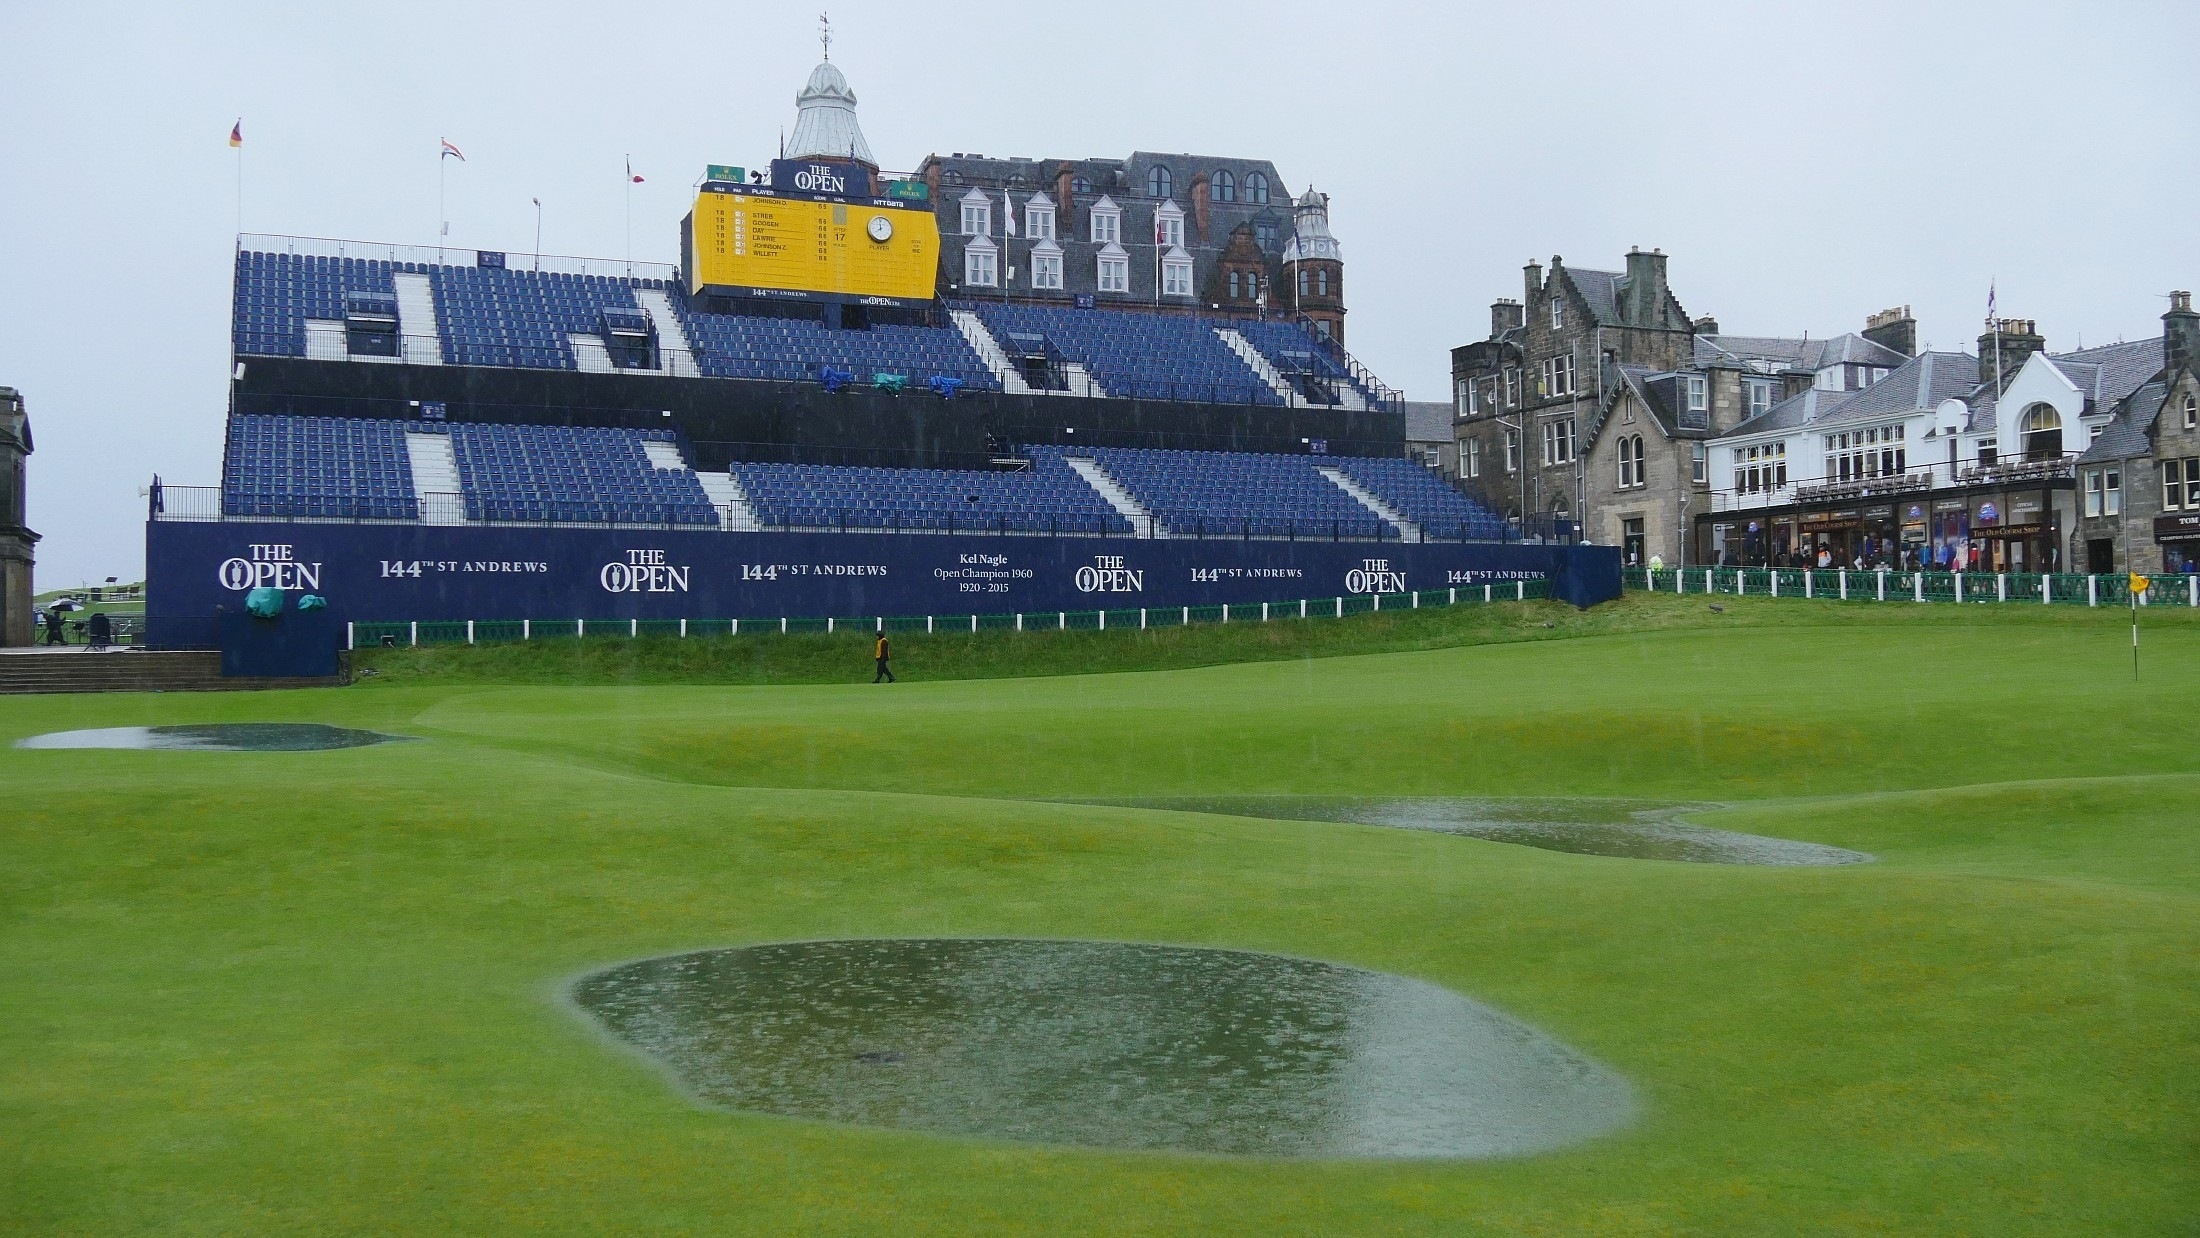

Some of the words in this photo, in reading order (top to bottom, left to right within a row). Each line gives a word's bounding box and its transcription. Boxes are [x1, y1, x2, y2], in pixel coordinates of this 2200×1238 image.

[809, 165, 831, 176] THE
[715, 173, 737, 181] ROLEX
[795, 171, 845, 193] OPEN
[751, 188, 774, 196] PLAYER
[752, 197, 782, 205] JOHNSON
[752, 212, 774, 220] STREB
[752, 220, 779, 228] GOOSEN
[752, 234, 776, 243] LAWRIE
[835, 233, 845, 241] 17
[753, 242, 783, 250] JOHNSON
[1813, 522, 1825, 530] OLD
[1824, 520, 1844, 529] COURSE
[1844, 518, 1858, 527] SHOP
[2179, 516, 2199, 525] TOM
[1986, 528, 2000, 536] OLD
[1999, 527, 2022, 535] COURSE
[2023, 526, 2041, 534] SHOP
[249, 544, 293, 561] THE
[627, 550, 665, 565] THE
[960, 554, 978, 564] Kel
[980, 554, 1008, 567] Nagle
[1094, 555, 1124, 569] THE
[1363, 559, 1389, 571] THE
[437, 561, 458, 572] ST
[462, 561, 548, 573] ANDREWS
[791, 565, 809, 575] ST
[813, 565, 887, 576] ANDREWS
[219, 558, 322, 591] OPEN
[600, 562, 690, 593] OPEN
[934, 568, 960, 580] Open
[962, 568, 1009, 580] Champion
[1011, 569, 1033, 578] 1960
[1228, 569, 1242, 577] ST
[1246, 568, 1302, 578] ANDREWS
[1480, 571, 1492, 579] ST
[1495, 571, 1545, 579] ANDREWS
[1075, 566, 1143, 592] OPEN
[1345, 569, 1406, 593] OPEN
[960, 583, 980, 592] 1920
[988, 583, 1009, 593] 2015
